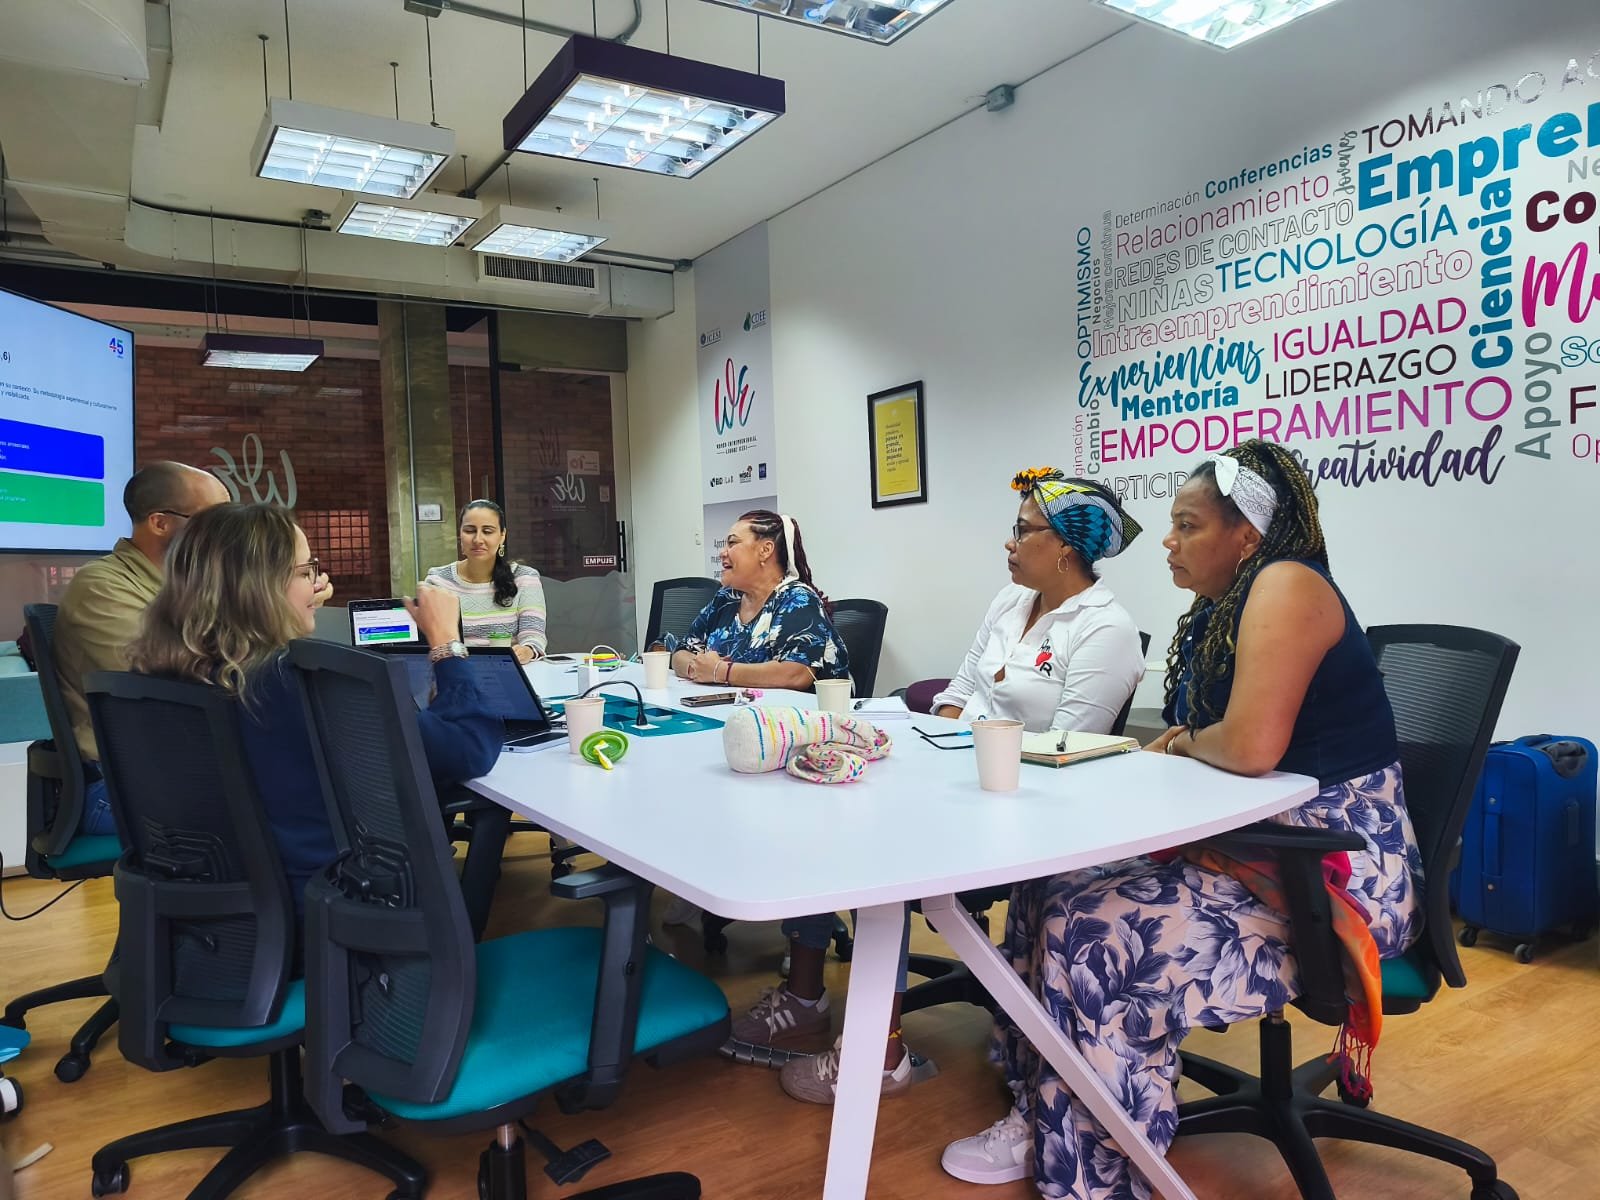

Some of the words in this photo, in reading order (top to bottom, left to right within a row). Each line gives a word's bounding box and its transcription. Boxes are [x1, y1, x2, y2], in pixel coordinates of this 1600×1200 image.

[1362, 71, 1546, 154] TOMANDO
[1205, 143, 1332, 199] Conferencias
[1115, 189, 1200, 229] Determinación
[1117, 174, 1330, 259] Relacionamiento
[1525, 190, 1597, 233] Co
[1114, 250, 1181, 290] REDES
[1185, 239, 1215, 270] DE
[1218, 197, 1355, 259] CONTACTO
[1215, 198, 1458, 293] TECNOLOGÍA
[1467, 177, 1514, 369] Ciencia
[1076, 226, 1092, 359] OPTIMISMO
[1092, 258, 1104, 325] Negocios
[1092, 247, 1474, 359] Intraemprendimiento
[1117, 273, 1214, 323] NIÑAS
[1521, 241, 1600, 328] M
[109, 337, 124, 355] 45
[1273, 297, 1467, 363] IGUALDAD
[1078, 337, 1265, 408] Experiencias
[1121, 381, 1239, 422] Mentoría
[1265, 344, 1457, 400] LIDERAZGO
[1515, 332, 1562, 460] Apoyo
[1570, 385, 1597, 424] F
[1072, 414, 1086, 479] ginación
[1086, 398, 1101, 475] Cambio
[1101, 376, 1513, 464] EMPODERAMIENTO
[1095, 470, 1191, 501] ARTICIP
[585, 556, 614, 565] EMPUJE
